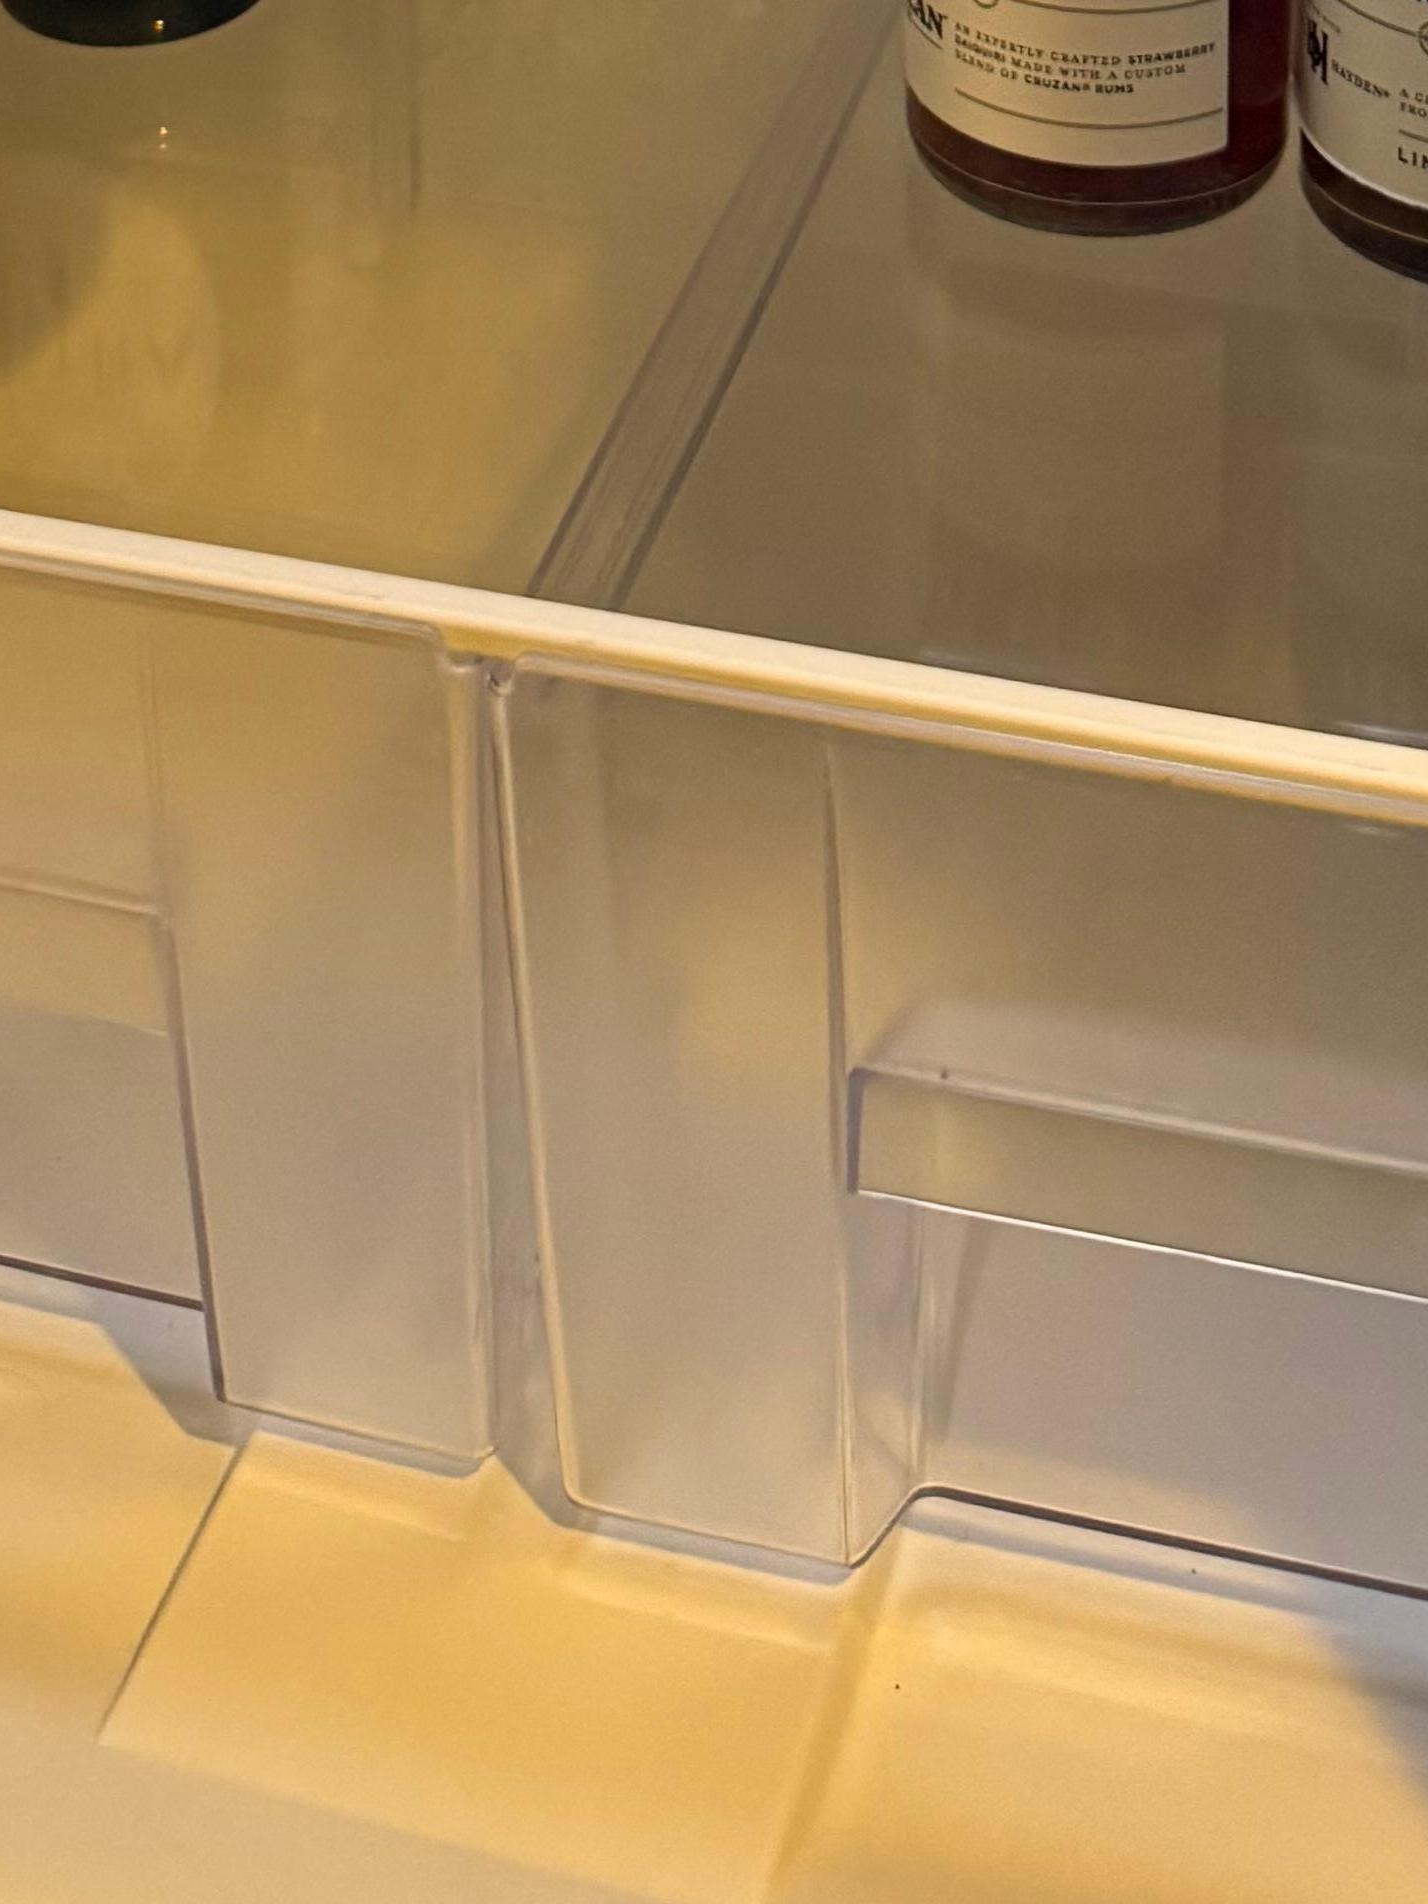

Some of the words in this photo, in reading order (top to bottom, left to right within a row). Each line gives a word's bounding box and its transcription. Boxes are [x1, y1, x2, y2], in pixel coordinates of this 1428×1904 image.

[1049, 50, 1122, 66] CRAFTED
[1127, 42, 1217, 66] STRAWBERRY
[1010, 57, 1053, 75] MADE
[1059, 65, 1101, 81] WITH
[1107, 69, 1119, 81] A
[1123, 63, 1187, 81] CUSTOM
[1094, 81, 1135, 94] RUMS
